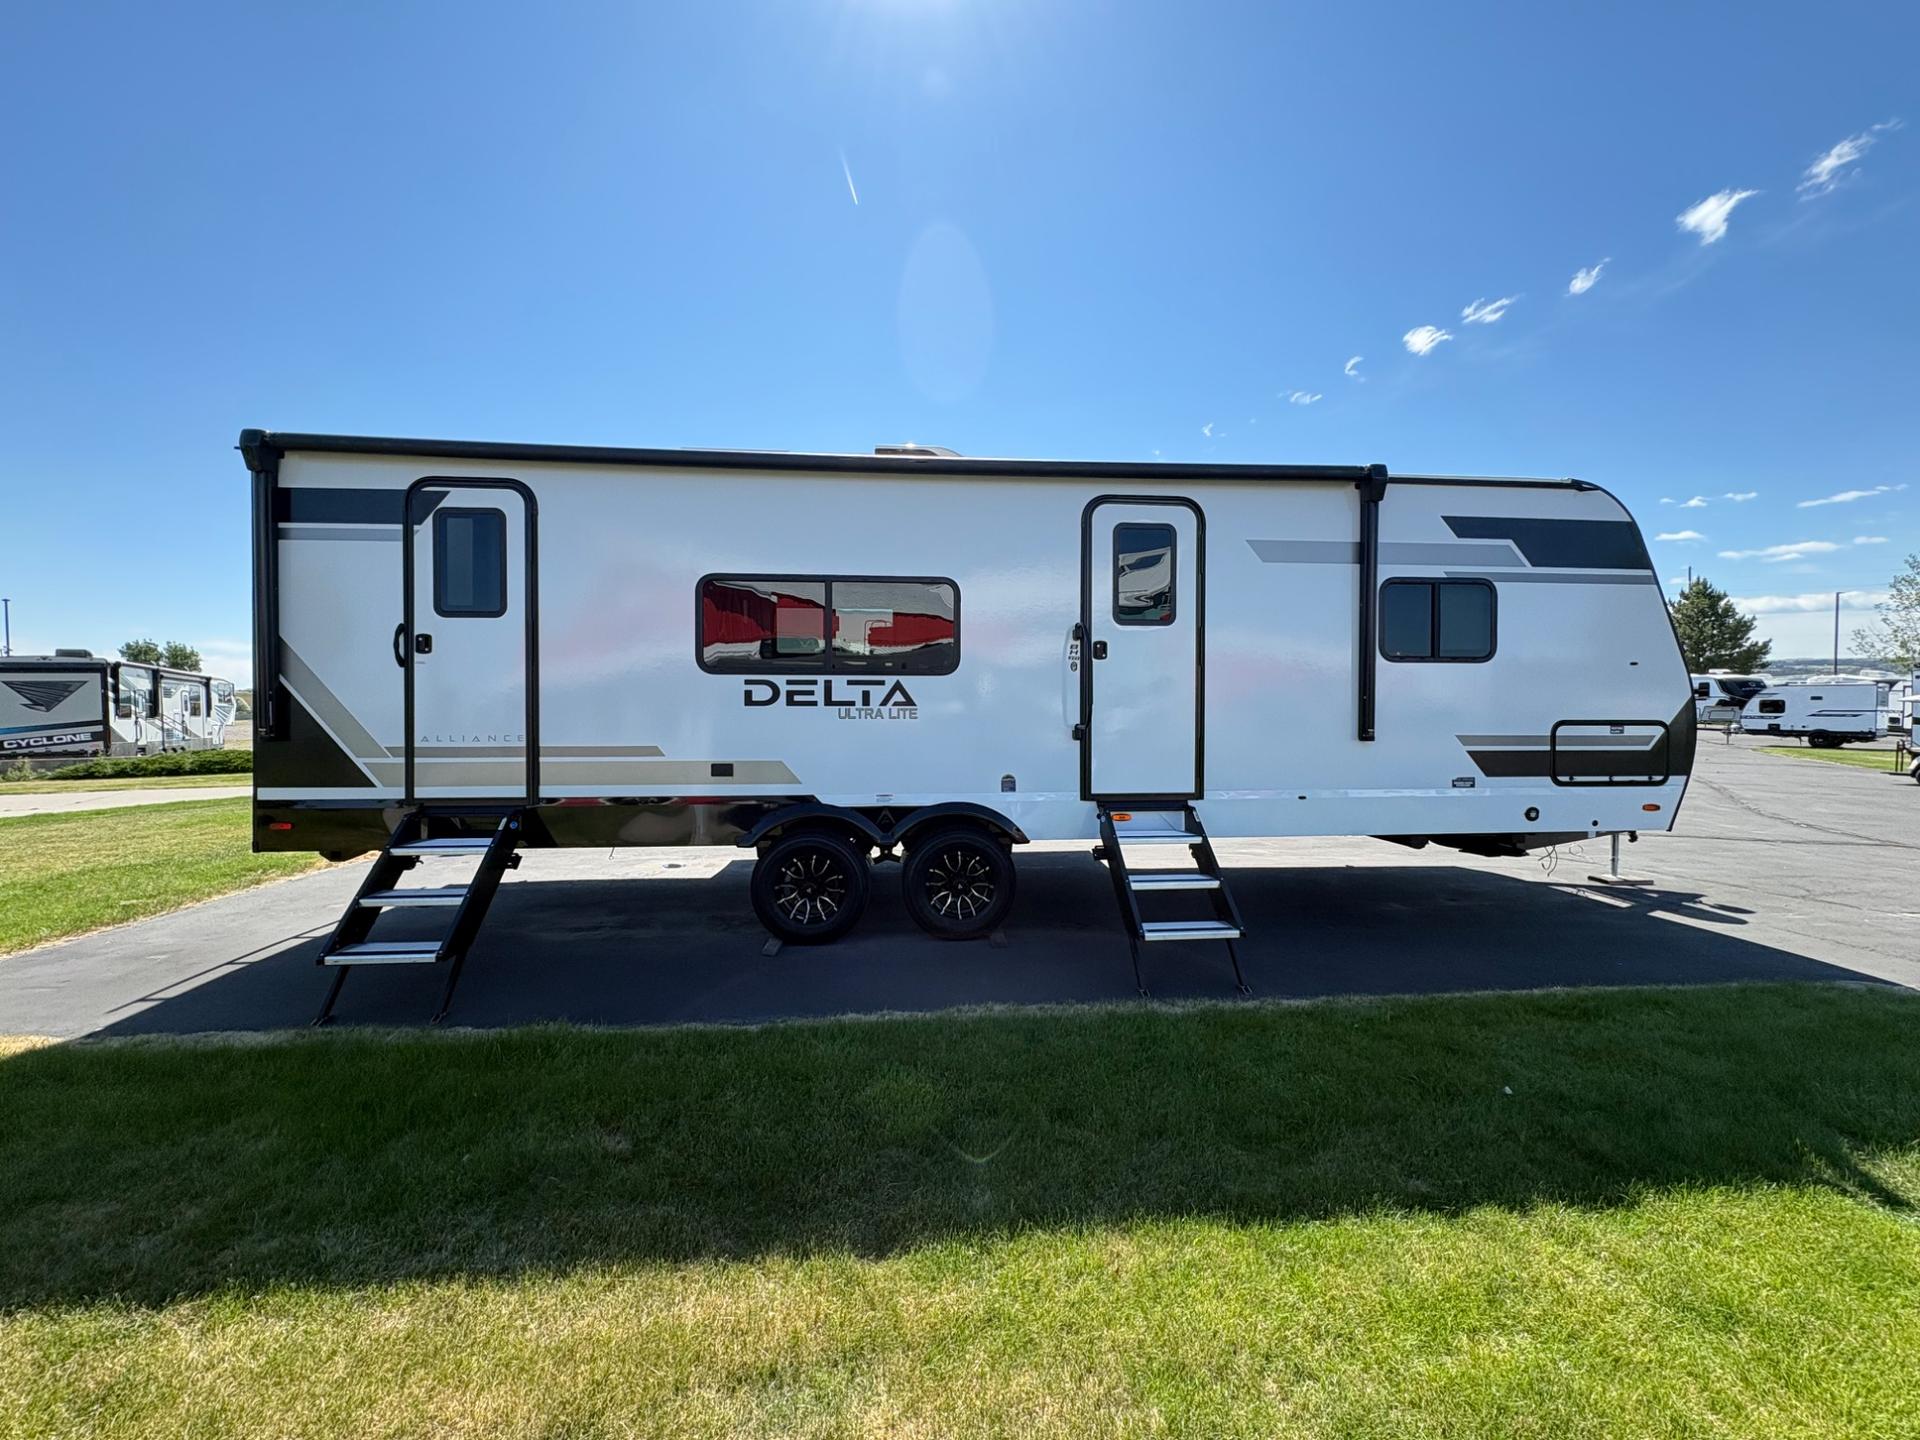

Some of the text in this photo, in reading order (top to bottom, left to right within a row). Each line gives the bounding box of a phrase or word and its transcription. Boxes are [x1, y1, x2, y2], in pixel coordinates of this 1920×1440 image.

[744, 679, 917, 706] DELTA
[838, 708, 918, 720] ULTRA LITE
[3, 733, 92, 748] CYCLONE
